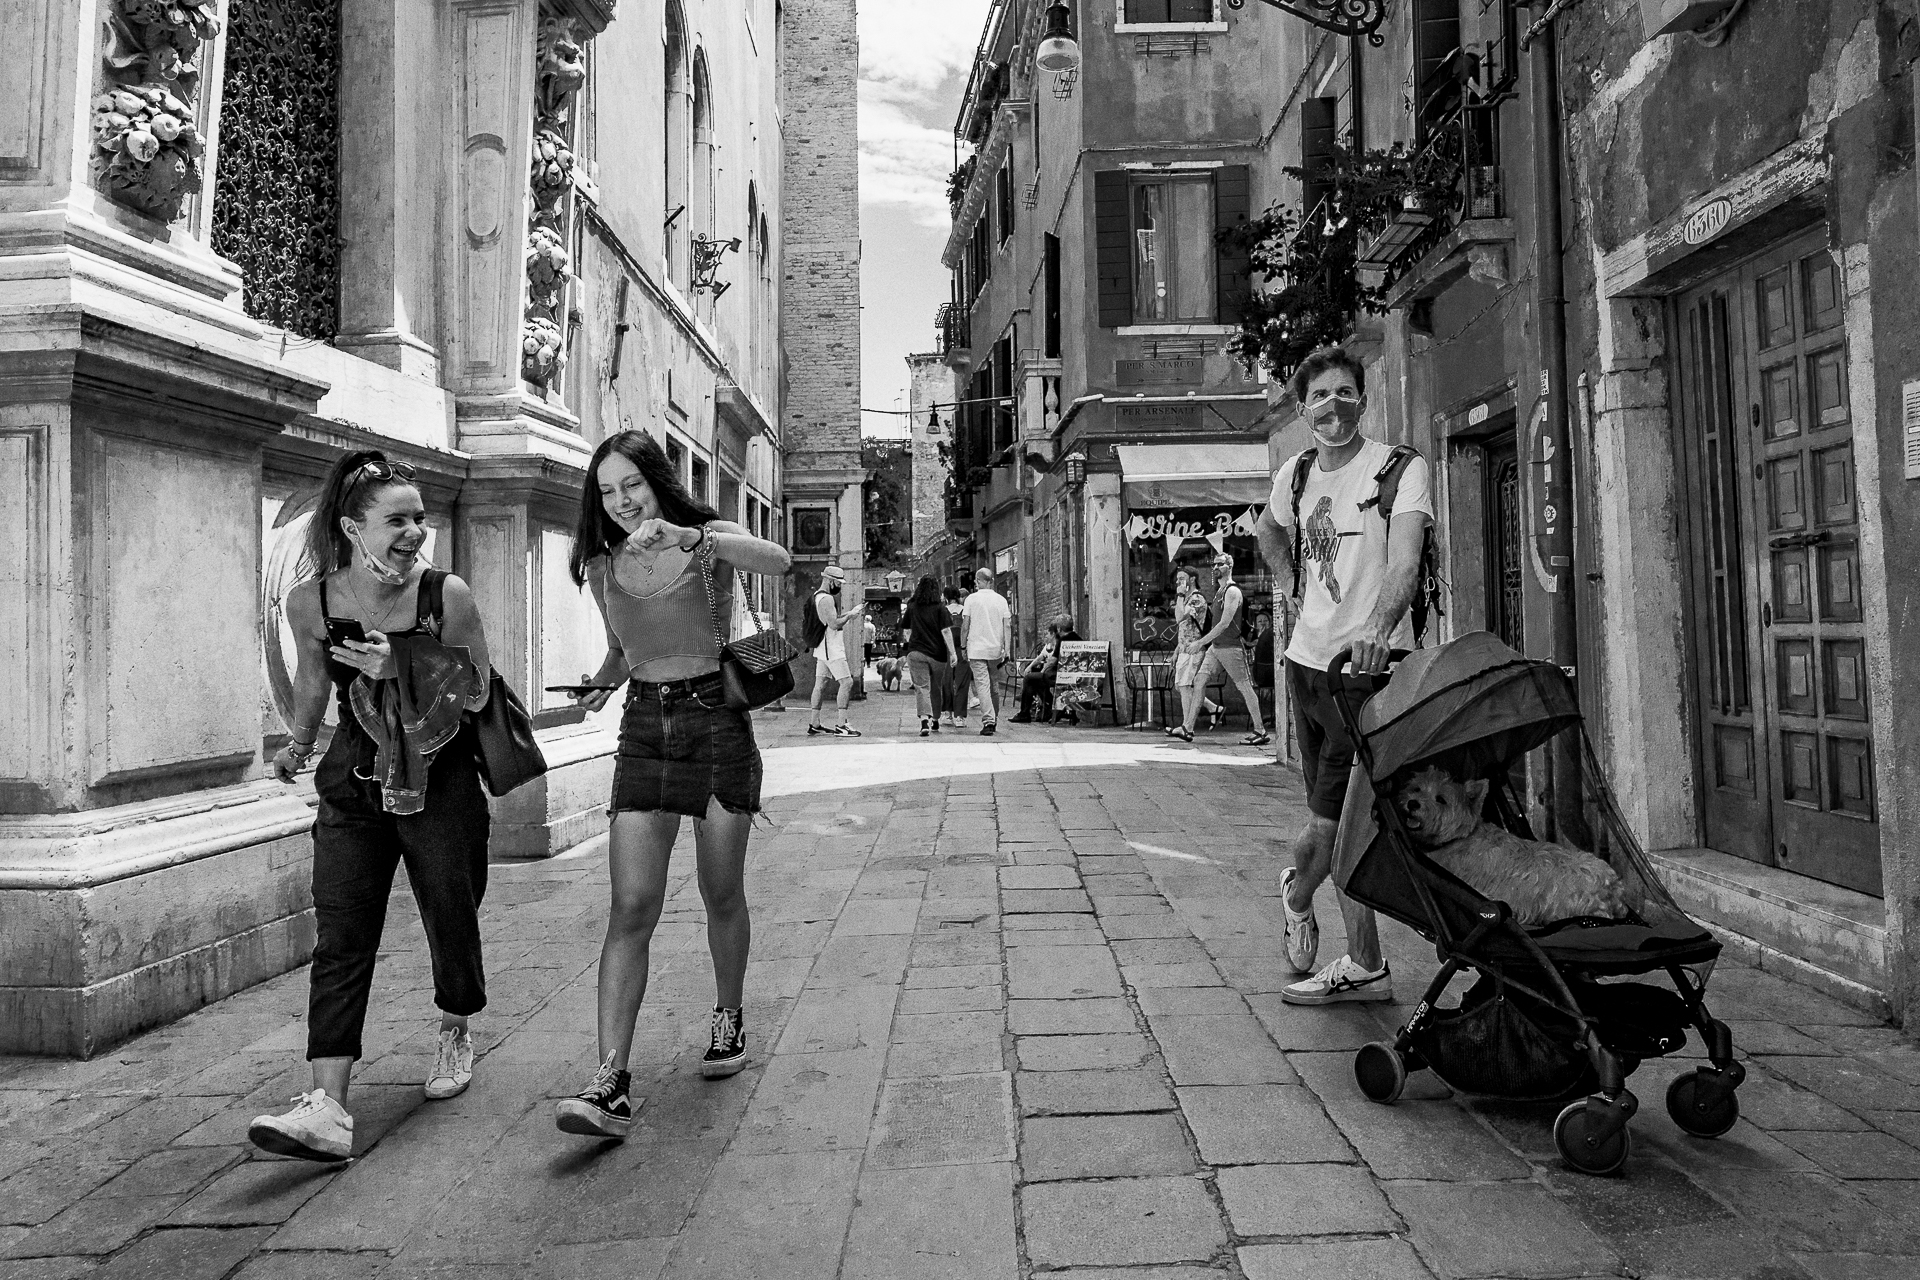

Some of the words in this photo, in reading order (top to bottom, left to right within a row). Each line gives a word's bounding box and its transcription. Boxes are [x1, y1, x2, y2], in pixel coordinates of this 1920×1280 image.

[1687, 201, 1726, 243] 6360
[1126, 362, 1145, 370] PER
[1158, 360, 1194, 369] MARCO
[1122, 407, 1141, 416] PER
[1144, 406, 1197, 415] ARSENALE
[1136, 512, 1205, 540] Wine
[1214, 512, 1257, 538] Ba
[1406, 1000, 1427, 1034] HAMILTON
